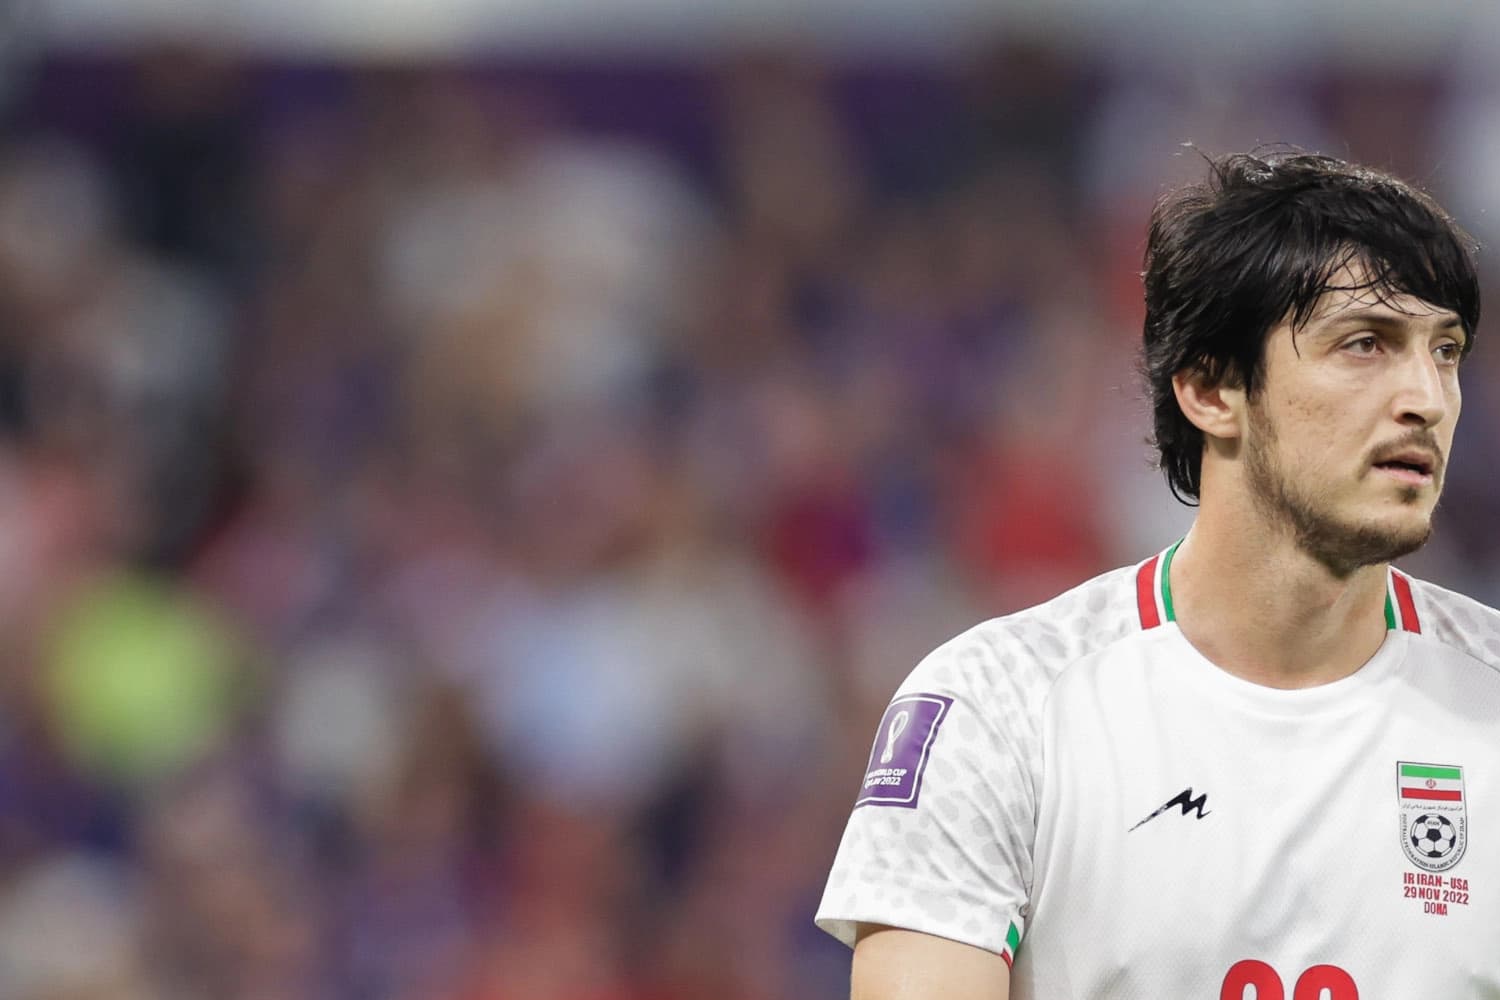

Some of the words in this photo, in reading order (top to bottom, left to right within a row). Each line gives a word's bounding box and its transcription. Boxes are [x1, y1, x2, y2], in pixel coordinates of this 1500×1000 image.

[1403, 872, 1415, 885] IR
[1450, 877, 1469, 892] USA
[1403, 886, 1417, 899] 29
[1418, 887, 1440, 901] NOV
[1443, 889, 1469, 905] 2022
[1424, 901, 1448, 916] DOHA
